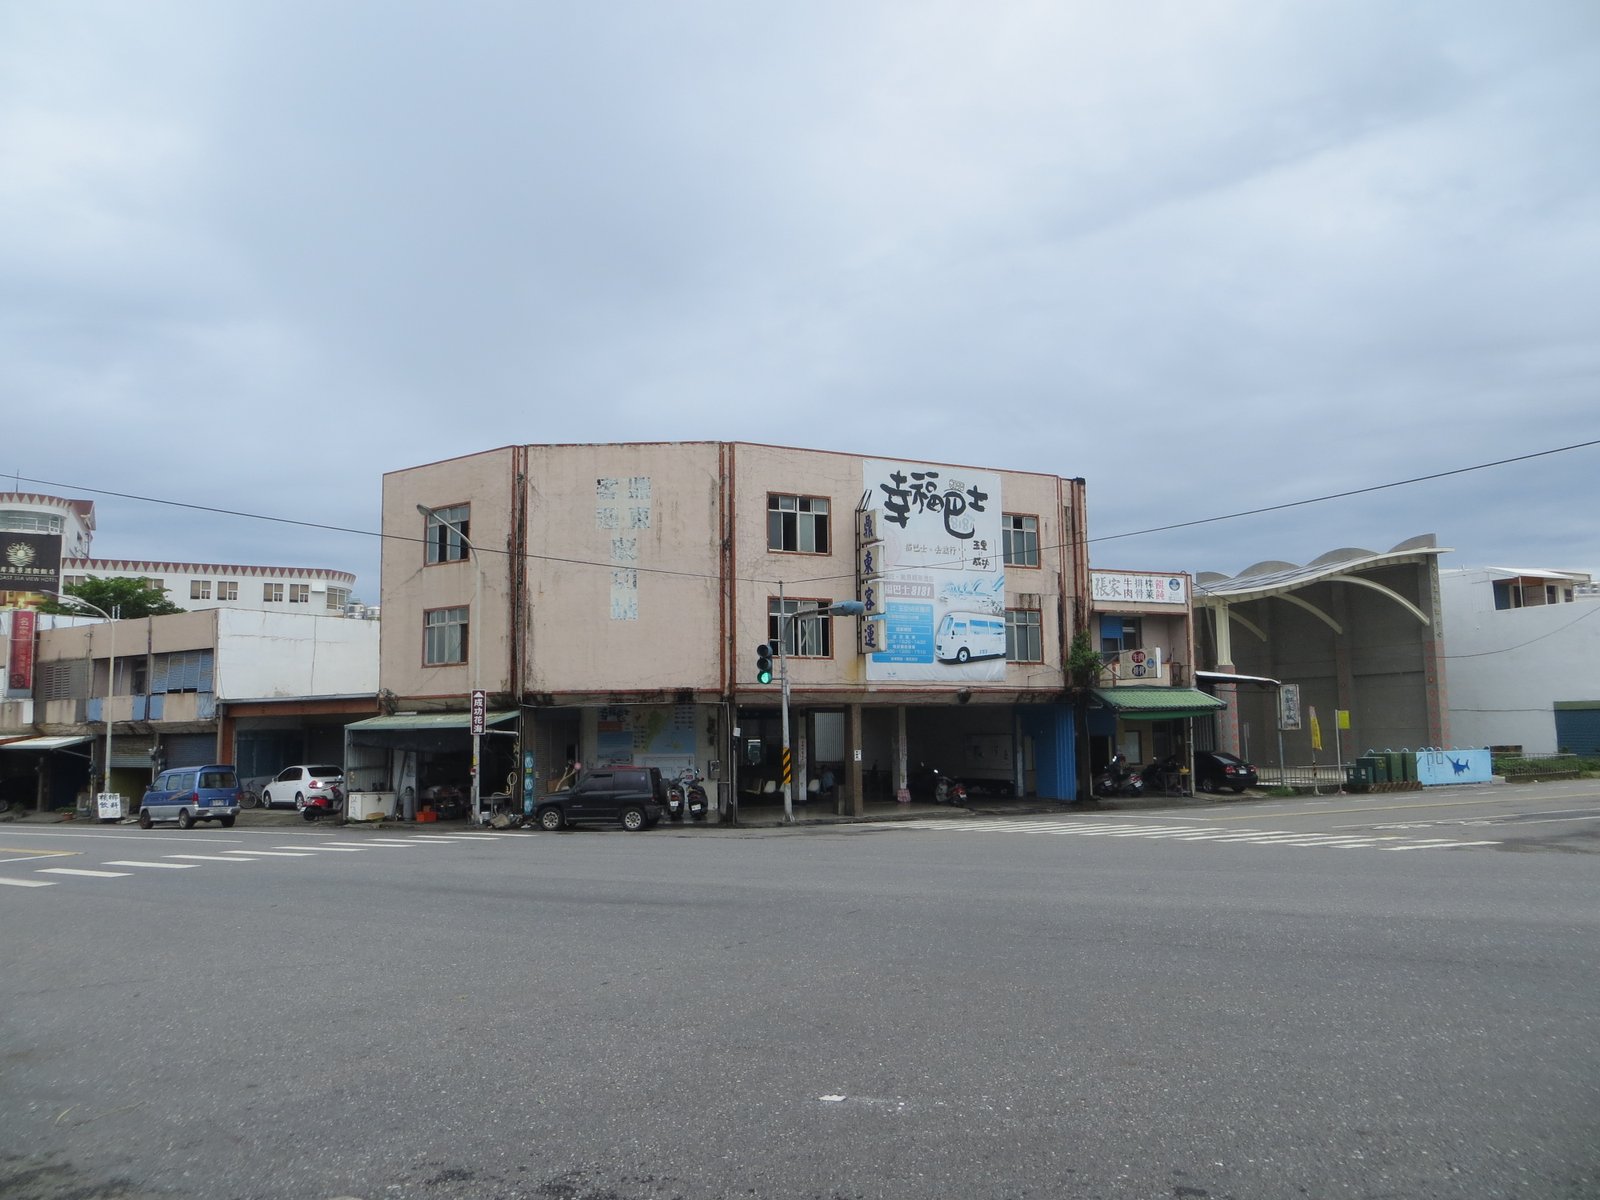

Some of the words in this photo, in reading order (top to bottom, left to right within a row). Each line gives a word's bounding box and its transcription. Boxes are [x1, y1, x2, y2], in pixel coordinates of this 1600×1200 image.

[880, 470, 988, 539] 幸福巴士
[863, 514, 877, 648] 鼎東客運
[1095, 576, 1121, 597] 張家
[1124, 577, 1133, 599] 牛肉
[474, 698, 483, 733] 成功花海
